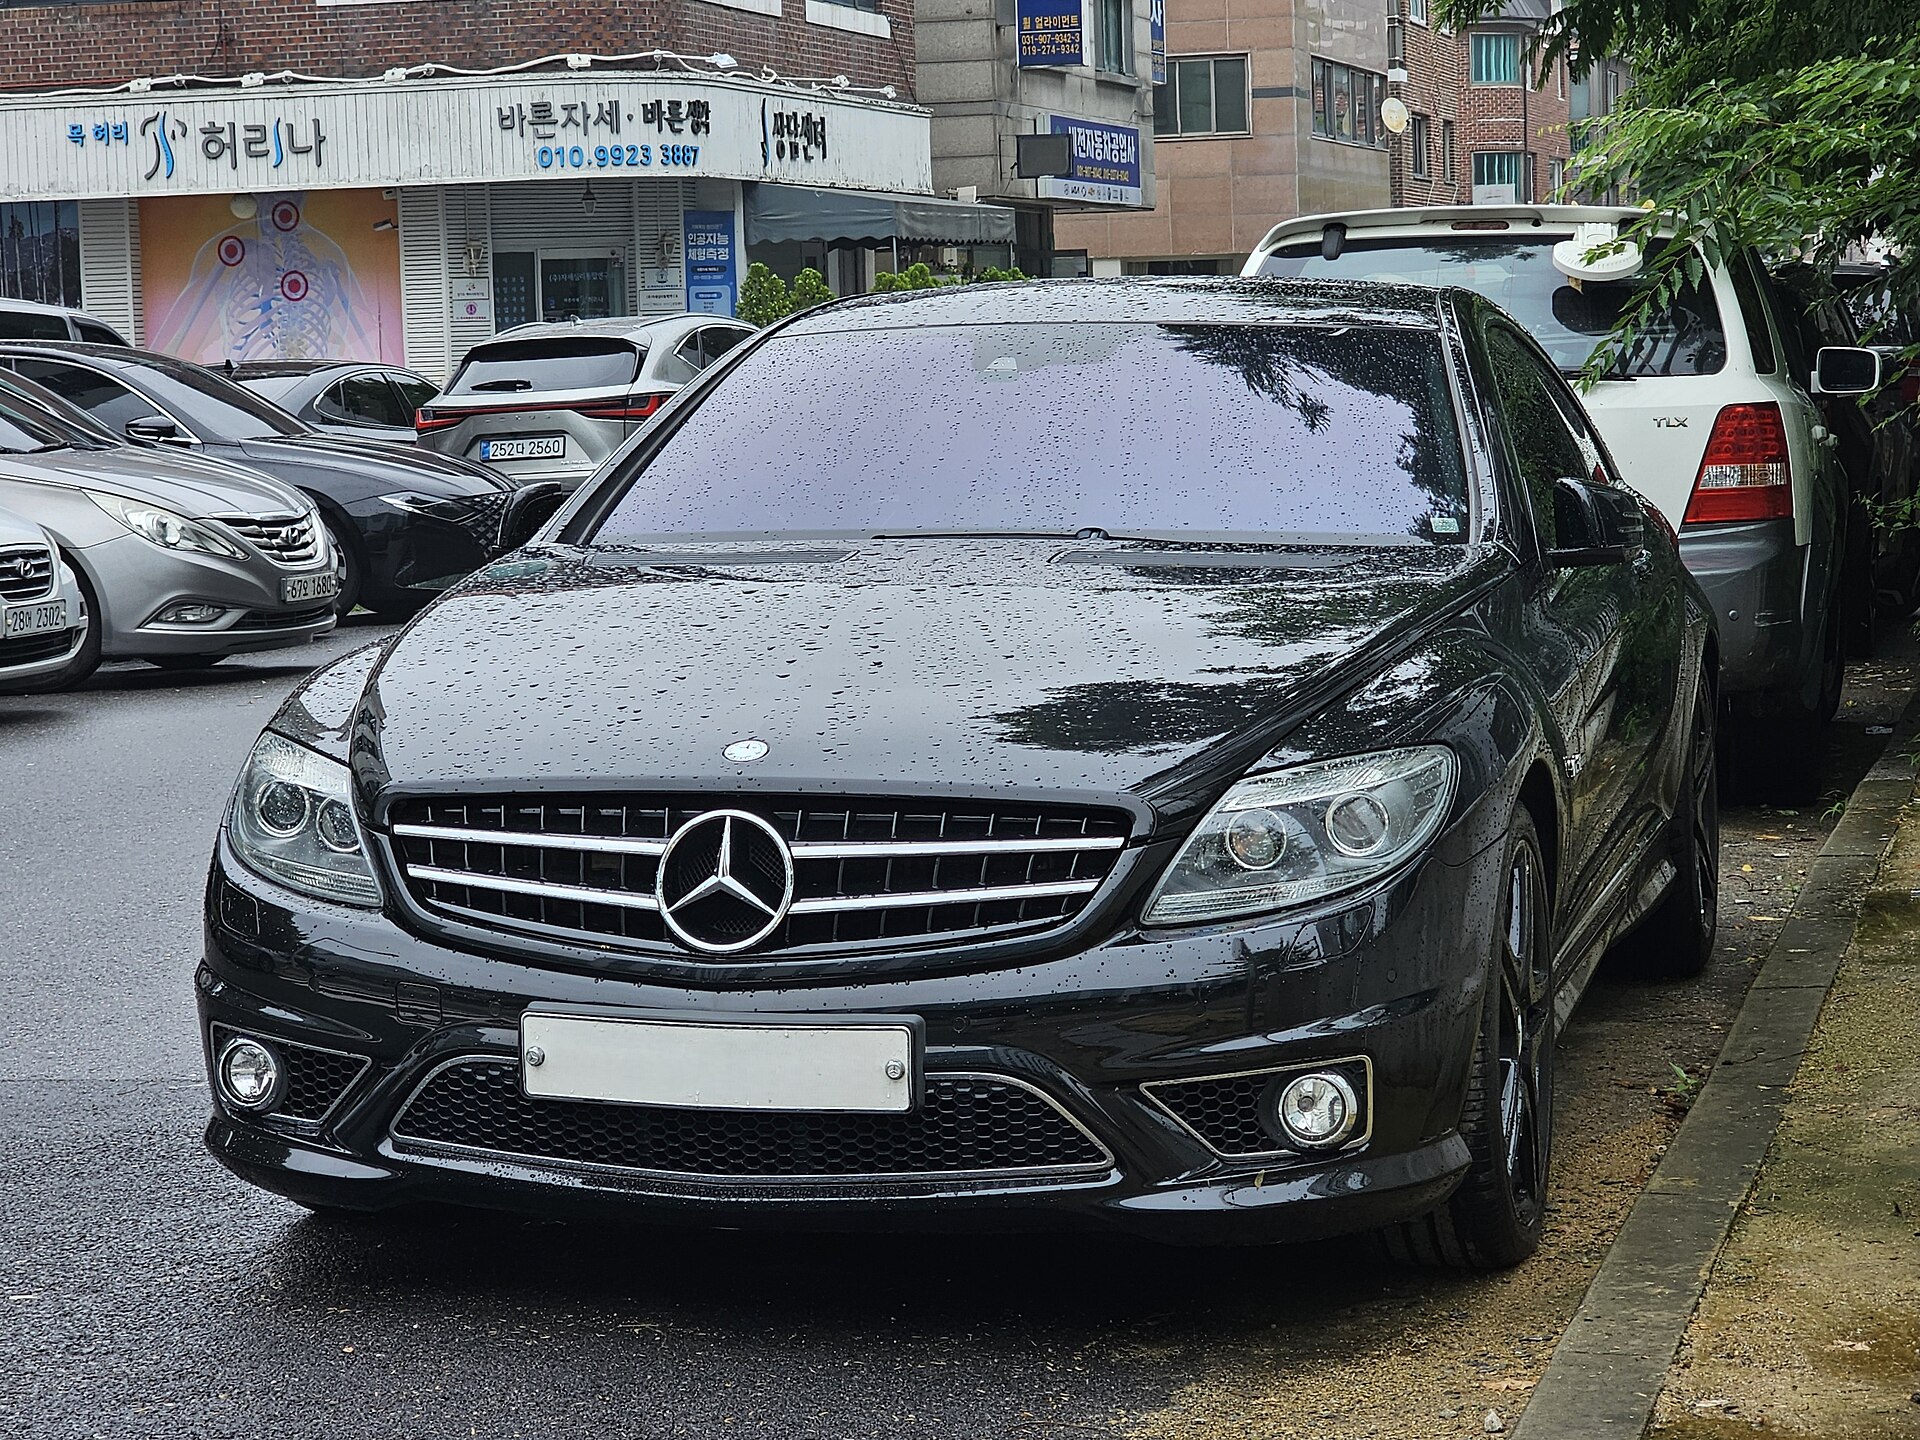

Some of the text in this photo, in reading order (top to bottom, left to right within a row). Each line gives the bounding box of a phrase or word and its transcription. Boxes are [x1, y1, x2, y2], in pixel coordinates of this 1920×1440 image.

[1034, 14, 1079, 30] 얼라이먼트
[1022, 44, 1080, 56] 019-274-9342
[67, 120, 129, 147] 목 허리
[772, 111, 827, 161] 상담센터
[687, 232, 729, 245] 인공지능
[1652, 416, 1688, 428] TLX
[528, 440, 560, 455] 2560
[312, 575, 332, 596] 1680
[36, 605, 60, 629] 2302
